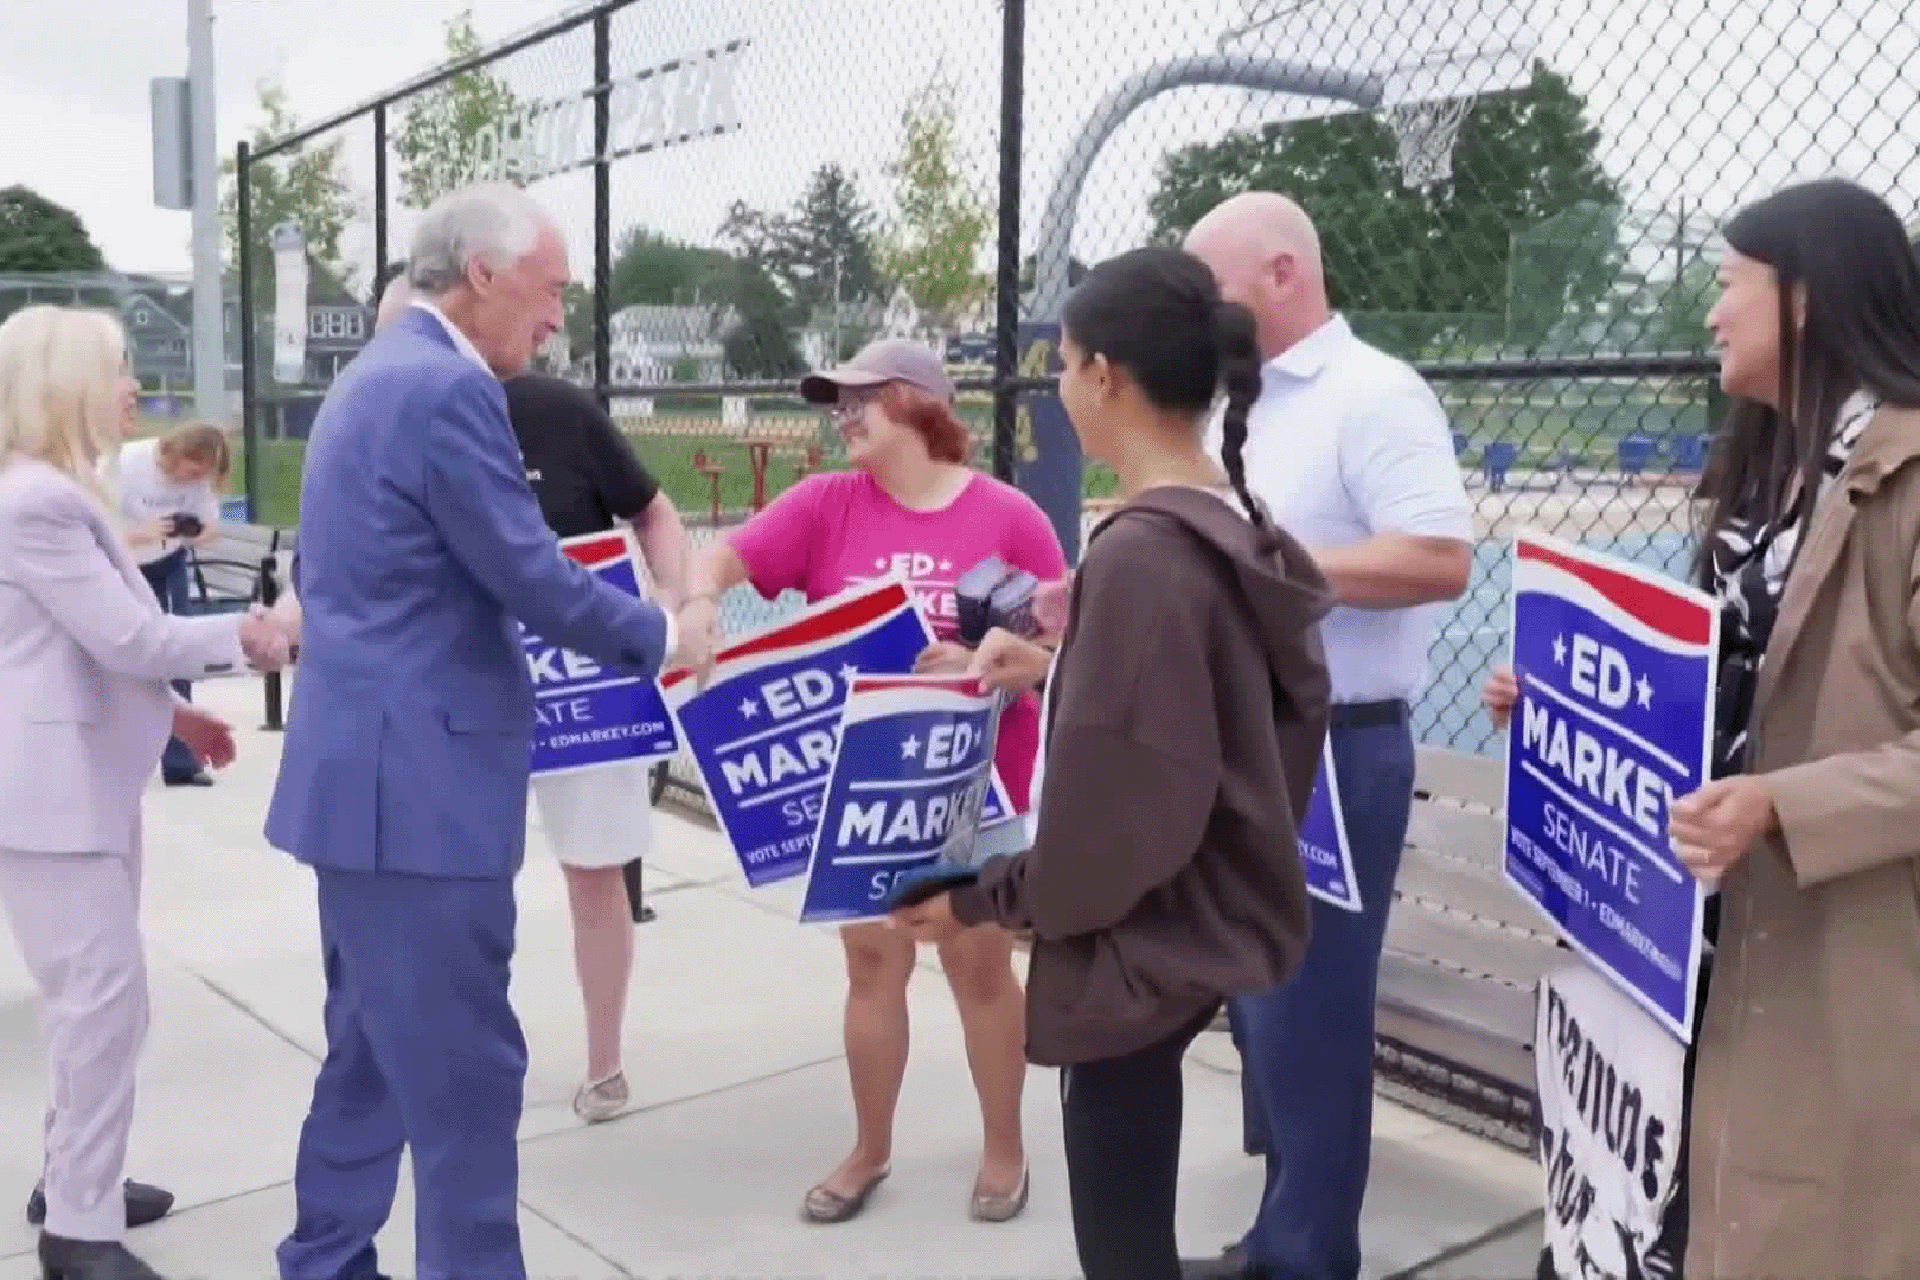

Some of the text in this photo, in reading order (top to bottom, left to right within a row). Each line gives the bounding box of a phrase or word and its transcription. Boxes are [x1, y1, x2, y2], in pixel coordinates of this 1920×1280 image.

[890, 552, 935, 578] ED
[760, 668, 835, 720] ED
[1571, 633, 1632, 710] ED
[550, 720, 665, 749] EDMARKEY.COM
[720, 723, 842, 795] MAR
[924, 721, 973, 769] ED
[1523, 696, 1672, 838] MARKE
[746, 843, 781, 864] VOTE
[1543, 800, 1642, 905] SENATE
